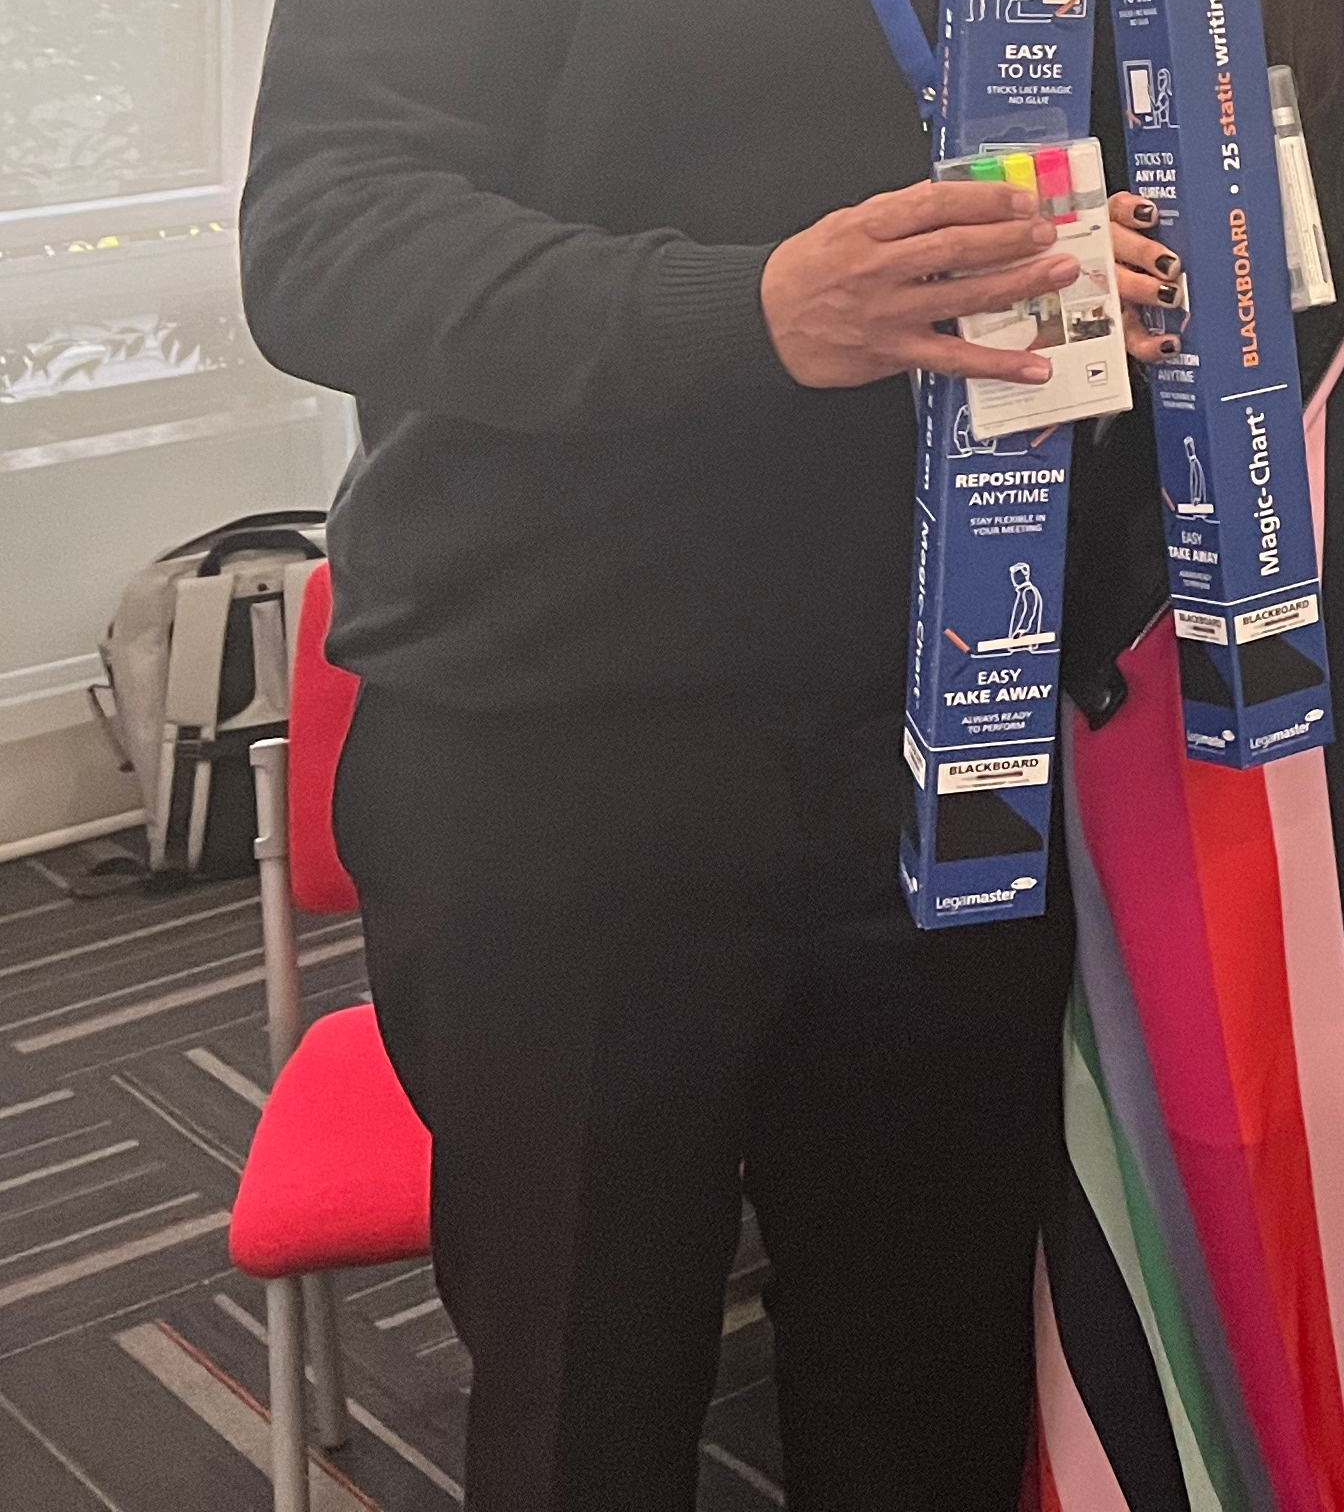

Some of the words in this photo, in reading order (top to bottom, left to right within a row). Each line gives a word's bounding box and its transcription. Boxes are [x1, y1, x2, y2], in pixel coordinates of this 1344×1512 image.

[1005, 44, 1058, 59] EASY
[998, 63, 1024, 79] TO
[1029, 63, 1063, 79] USE
[986, 85, 1018, 95] STICKS
[1040, 86, 1073, 95] MAGIC
[1025, 96, 1050, 105] GLUE
[1215, 71, 1237, 137] static
[1134, 152, 1161, 166] STICKS
[1162, 152, 1174, 166] TO
[1222, 142, 1241, 171] 25
[1135, 169, 1155, 183] ANY
[1156, 169, 1176, 182] FLAT
[1229, 207, 1260, 368] BLACKBOARD
[955, 469, 1065, 488] REPOSITION
[968, 488, 1050, 506] ANYTIME
[970, 516, 993, 526] STAY
[994, 514, 1034, 526] FLEXIBLE
[973, 526, 1000, 536] YOUR
[1001, 524, 1043, 534] MEETING
[1182, 530, 1202, 545] EASY
[1168, 545, 1191, 562] TAKE
[1242, 599, 1310, 626] BLACKBOARD
[977, 668, 1022, 686] EASY
[944, 690, 992, 706] TAKE
[995, 684, 1053, 703] AWAY
[961, 713, 1000, 725] ALWAYS
[1000, 711, 1033, 723] READY
[968, 724, 981, 734] TO
[982, 720, 1026, 732] PERFORM
[1250, 721, 1311, 750] Legamaster
[949, 758, 1039, 776] BLACKBOARD
[935, 888, 1017, 911] Legamaster
